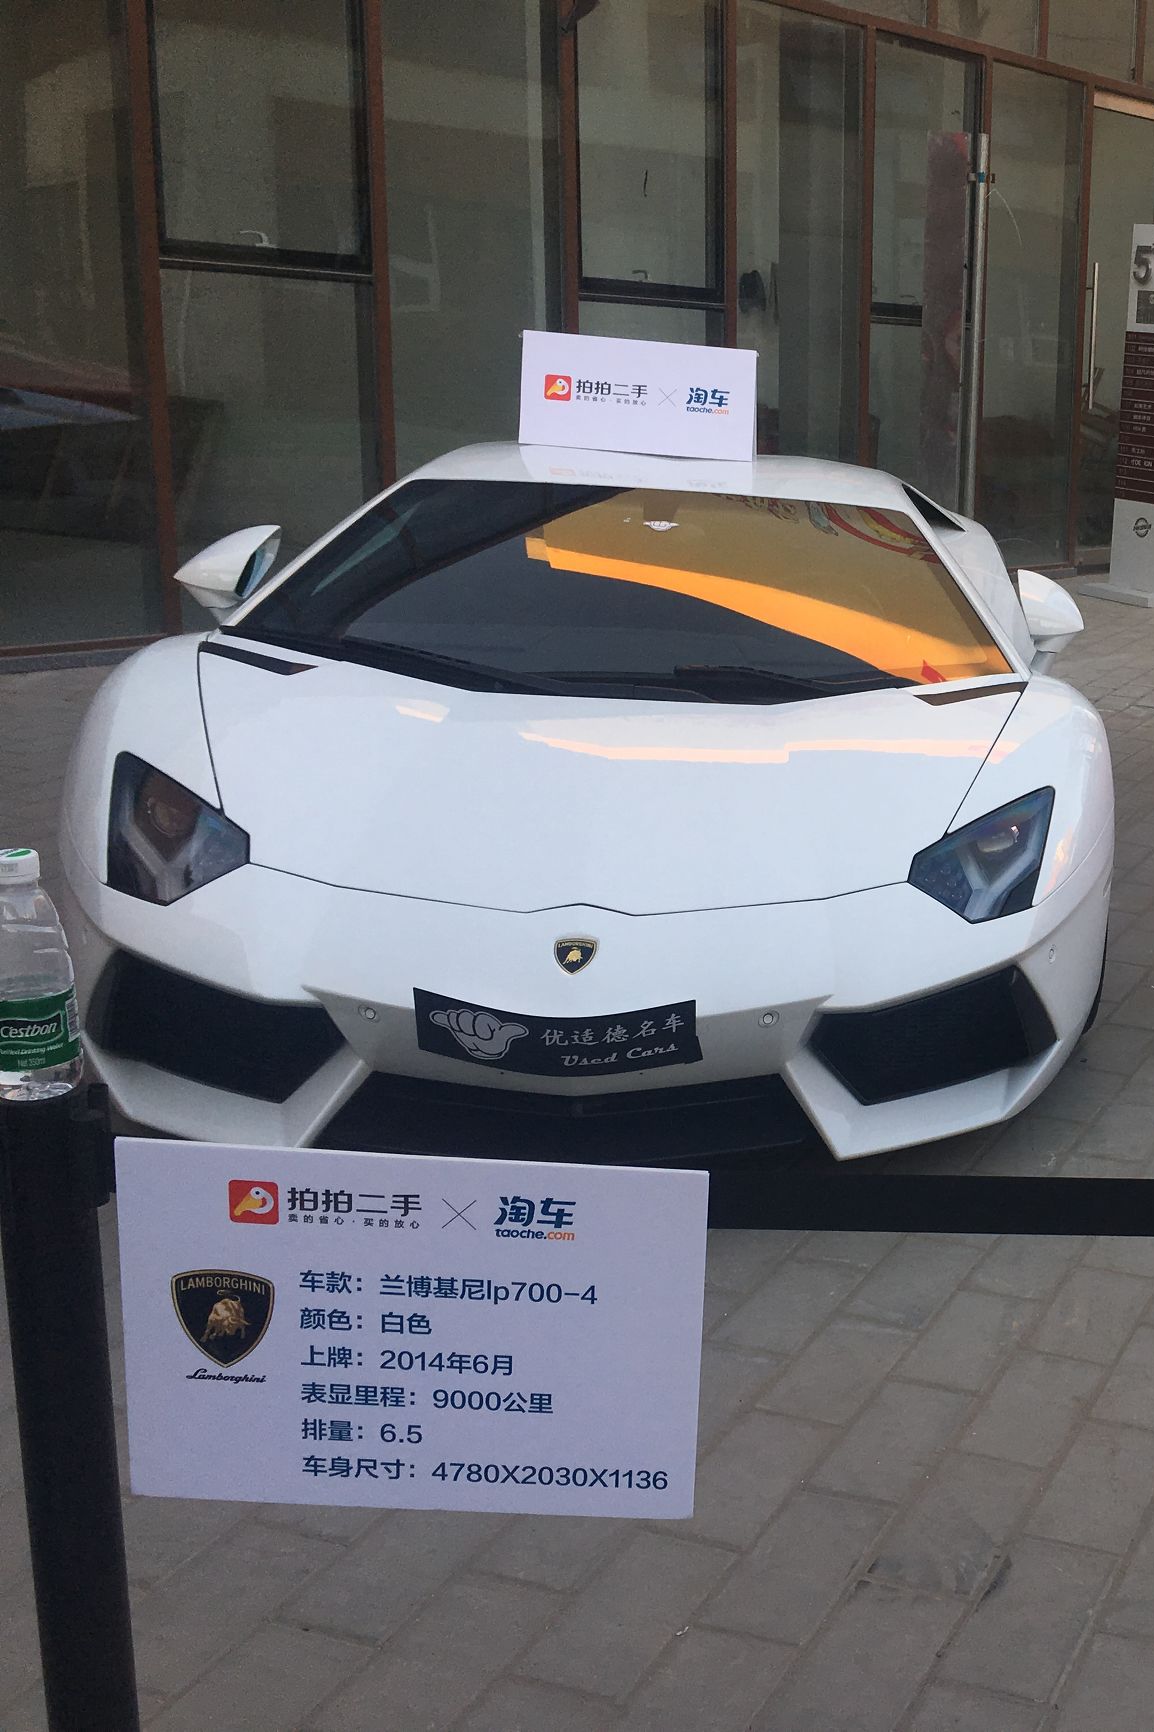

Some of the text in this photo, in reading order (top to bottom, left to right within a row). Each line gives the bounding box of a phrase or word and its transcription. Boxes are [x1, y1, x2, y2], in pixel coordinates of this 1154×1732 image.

[576, 378, 648, 399] 拍拍二手
[686, 387, 730, 407] 淘车
[686, 406, 730, 415] taoche.com
[540, 1012, 685, 1048] 优适德名车
[560, 1043, 679, 1067] Used Cars
[288, 1187, 422, 1217] 拍拍二手
[494, 1196, 576, 1228] 淘车
[495, 1228, 575, 1241] taoche.com
[180, 1276, 266, 1296] LAMBORGHINI
[186, 1368, 266, 1385] Lamborghini
